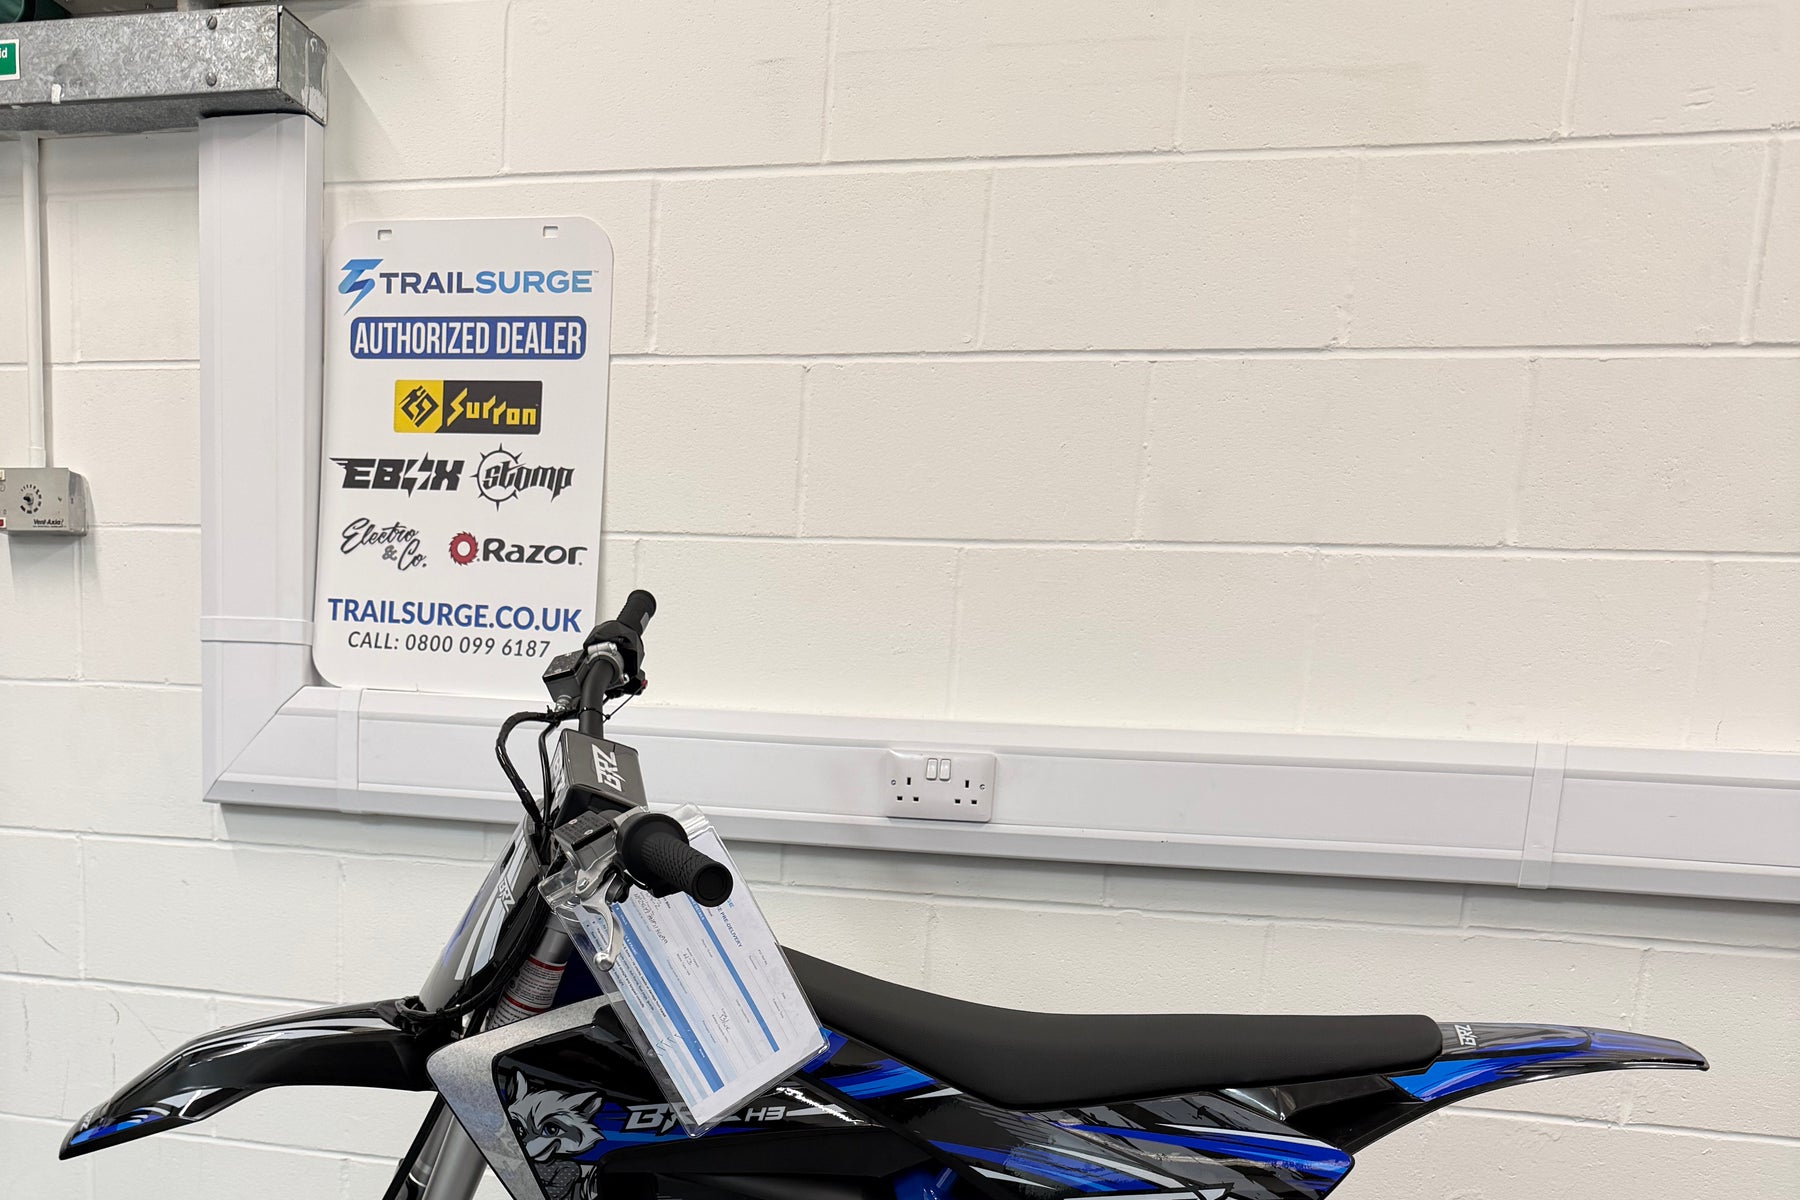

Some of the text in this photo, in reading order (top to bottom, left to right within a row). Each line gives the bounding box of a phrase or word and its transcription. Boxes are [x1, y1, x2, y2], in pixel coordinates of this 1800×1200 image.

[379, 270, 593, 294] TRAILSURGE
[354, 321, 582, 355] AUTHORIZED DEALER
[340, 517, 420, 554] Electro
[327, 598, 582, 633] TRAILSURGE.CO.UK
[347, 631, 551, 658] CALL: 0800 099 6187
[591, 744, 626, 792] BRZ
[744, 1106, 787, 1122] H3
